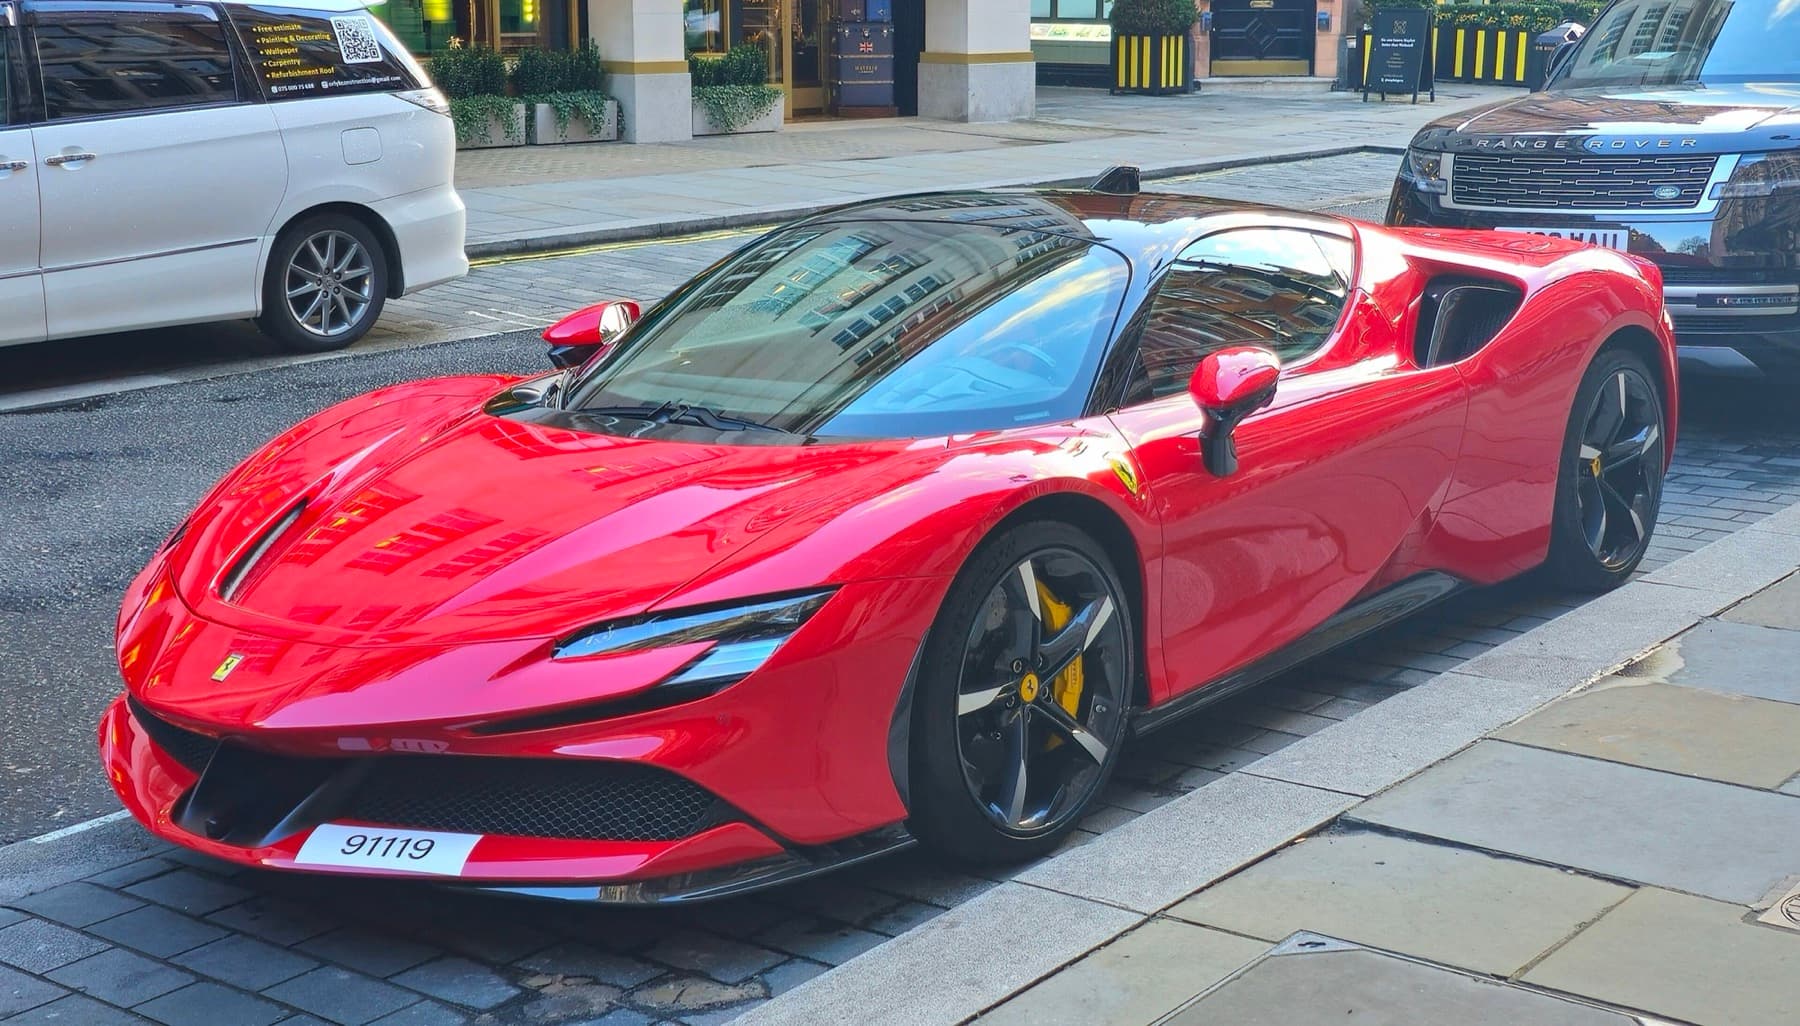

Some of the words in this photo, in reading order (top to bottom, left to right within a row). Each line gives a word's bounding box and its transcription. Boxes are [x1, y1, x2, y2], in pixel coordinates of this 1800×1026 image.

[257, 25, 272, 33] Free
[273, 24, 302, 32] estimate
[261, 36, 289, 44] Painting
[289, 34, 295, 42] &
[296, 32, 331, 41] Decorating
[264, 47, 298, 56] Wallpaper
[268, 59, 301, 68] Carpentry
[271, 69, 319, 79] Refurbishment
[320, 66, 335, 75] Roof
[1476, 139, 1569, 149] RANGE
[1588, 139, 1697, 149] ROVER
[341, 834, 435, 860] 91119
